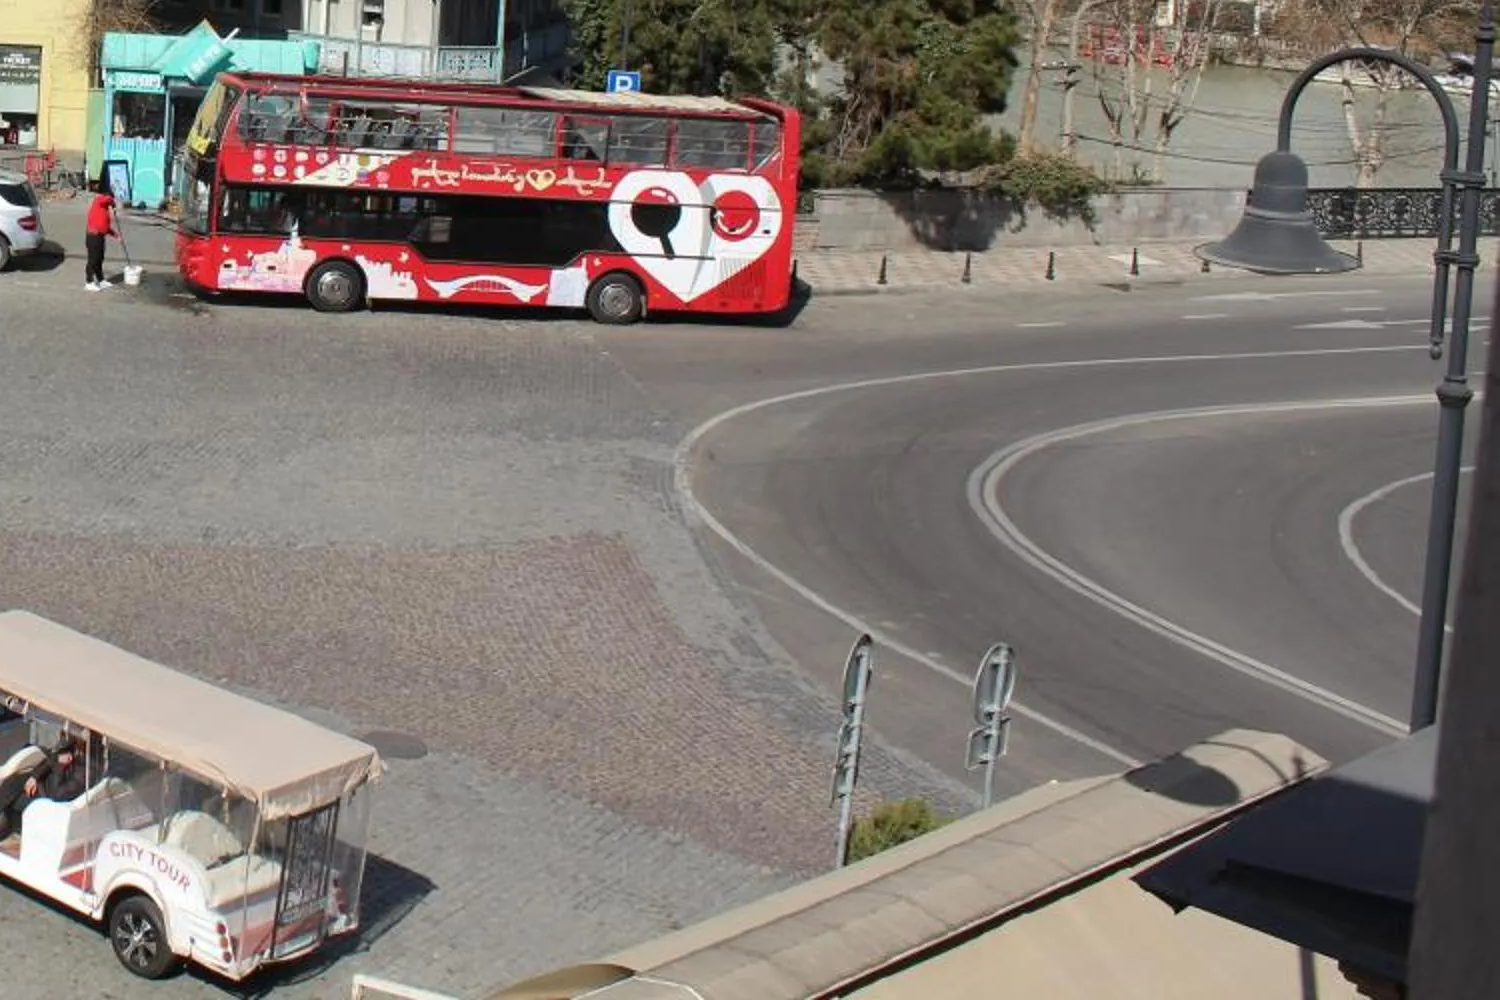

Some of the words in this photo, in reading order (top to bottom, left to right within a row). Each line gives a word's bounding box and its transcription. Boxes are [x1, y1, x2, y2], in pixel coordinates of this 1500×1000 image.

[614, 75, 633, 93] P
[109, 841, 145, 862] CITY
[147, 851, 191, 893] TOUR
